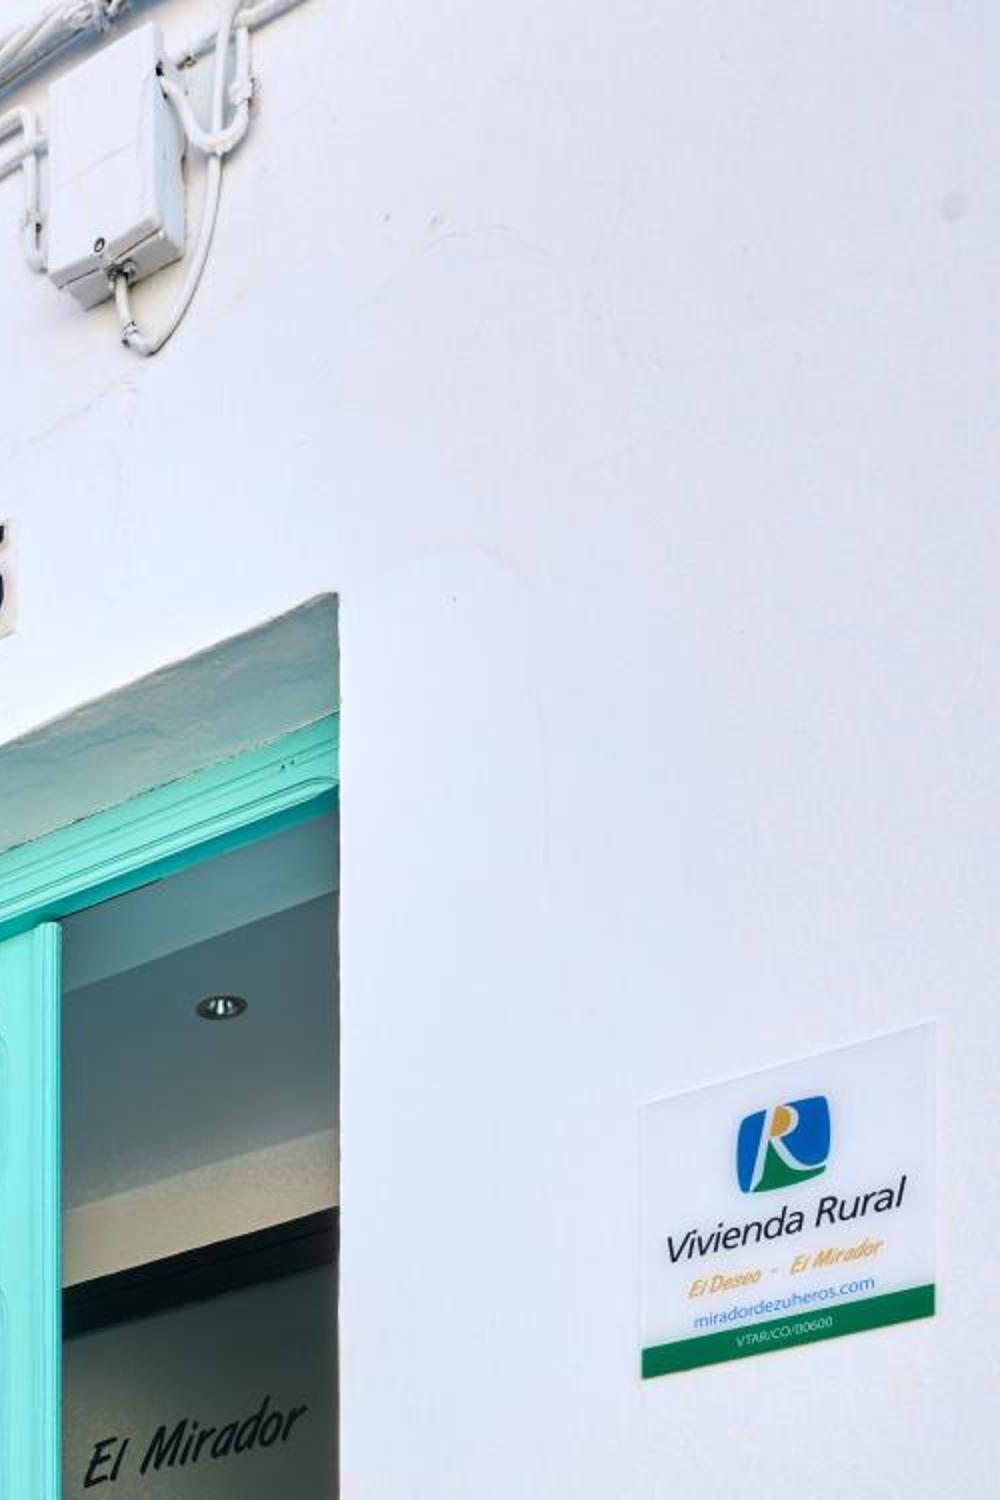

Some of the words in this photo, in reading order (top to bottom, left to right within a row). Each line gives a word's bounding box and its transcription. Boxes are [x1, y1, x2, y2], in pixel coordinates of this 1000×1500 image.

[667, 1206, 804, 1264] Vivienda
[815, 1175, 907, 1228] Rural
[688, 1278, 707, 1300] El
[708, 1269, 762, 1293] Deseo
[790, 1253, 808, 1276] El
[812, 1237, 884, 1268] Mirador
[693, 1276, 876, 1329] miradordezuheros.com
[83, 1436, 132, 1489] El
[139, 1395, 308, 1475] Mirador
